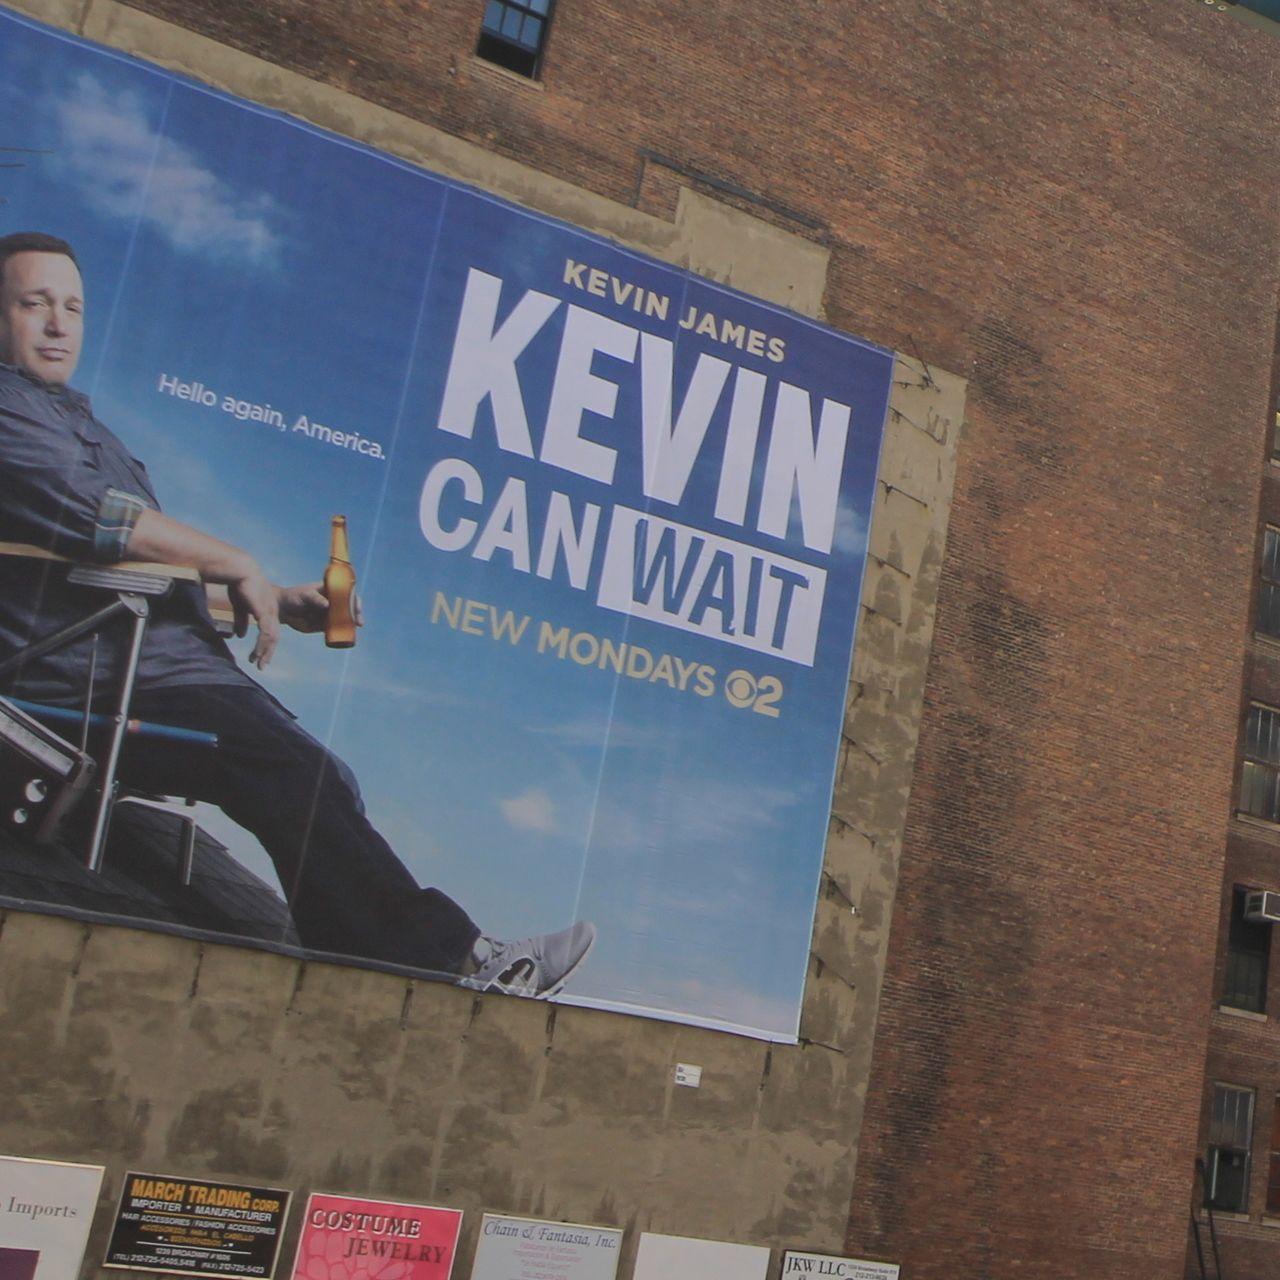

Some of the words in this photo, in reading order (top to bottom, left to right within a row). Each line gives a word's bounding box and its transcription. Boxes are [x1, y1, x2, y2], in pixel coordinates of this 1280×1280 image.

[562, 258, 670, 321] KEVIN
[679, 306, 787, 363] JAMES
[158, 373, 217, 407] Hello
[222, 396, 287, 432] again,
[292, 415, 386, 460] America.
[437, 267, 852, 555] KEVIN
[418, 458, 601, 591] CAN
[632, 517, 810, 651] WAIT
[431, 592, 530, 645] NEW
[537, 621, 716, 698] MONDAYS
[7, 1197, 78, 1220] Imports
[130, 1179, 186, 1202] MARCH
[188, 1186, 252, 1209] TRADING
[252, 1198, 280, 1213] CORP.
[131, 1198, 182, 1212] IMPORTER
[194, 1206, 272, 1222] MANUFACTURER
[122, 1212, 139, 1221] HAIR
[141, 1215, 191, 1227] ACCESSORIES
[227, 1224, 277, 1235] ACCESSORIES
[311, 1209, 422, 1239] COSTUME
[484, 1220, 519, 1237] Chain
[595, 1234, 617, 1249] Inc.
[344, 1237, 448, 1264] JEWELRY
[785, 1256, 816, 1274] JKW
[818, 1261, 847, 1277] LLC
